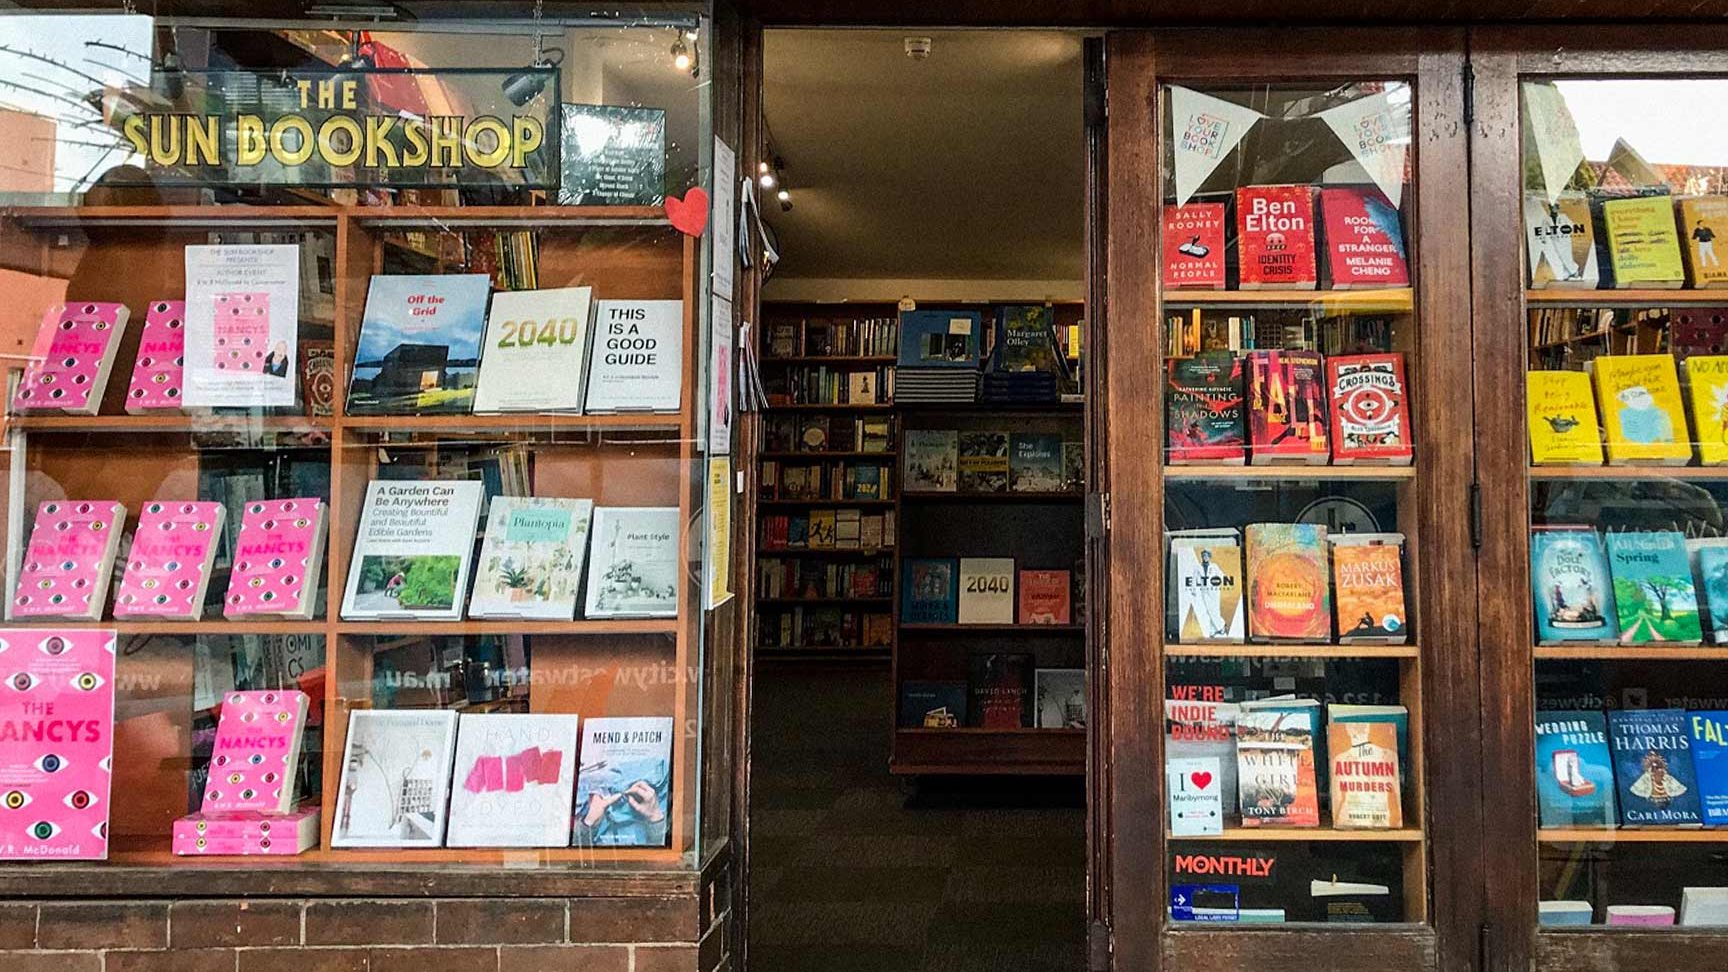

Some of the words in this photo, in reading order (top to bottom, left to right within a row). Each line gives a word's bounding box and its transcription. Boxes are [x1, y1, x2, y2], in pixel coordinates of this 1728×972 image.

[297, 80, 357, 109] THE
[122, 113, 222, 167] SUN
[235, 114, 544, 168] BOOKSHOP
[1253, 198, 1296, 215] Ben
[1176, 211, 1212, 220] SALLY
[1168, 220, 1220, 231] ROONEY
[1246, 214, 1305, 232] Elton
[1354, 226, 1377, 235] FOR
[1534, 224, 1585, 237] ELTON
[1362, 235, 1371, 244] A
[1338, 244, 1397, 253] STRANGER
[1257, 253, 1296, 265] IDENTITY
[1345, 257, 1394, 267] MELANIE
[1170, 262, 1218, 270] NORMAL
[1263, 265, 1293, 276] CRISIS
[1351, 266, 1391, 276] CHENG
[1173, 269, 1215, 279] PEOPLE
[407, 295, 426, 305] Off
[427, 295, 445, 305] the
[412, 307, 437, 317] Grid
[609, 308, 646, 320] THIS
[498, 317, 578, 349] 2040
[608, 324, 623, 335] IS
[627, 324, 640, 335] A
[1007, 328, 1048, 340] Margaret
[606, 338, 657, 350] GOOD
[1006, 338, 1030, 347] Olley
[604, 353, 657, 366] GUIDE
[1339, 374, 1396, 392] CROSSINGS
[1174, 392, 1238, 402] PAINTING
[1174, 409, 1239, 420] SHADOWS
[1018, 441, 1034, 450] She
[377, 486, 386, 496] A
[388, 486, 430, 496] Garden
[432, 486, 455, 496] Can
[375, 497, 390, 506] Be
[391, 497, 449, 509] Anywhere
[372, 508, 409, 518] Creating
[410, 507, 449, 516] Bountiful
[370, 518, 388, 526] and
[388, 518, 427, 526] Beautiful
[513, 516, 566, 532] Plantopia
[368, 528, 395, 537] Edible
[396, 528, 433, 537] Gardens
[626, 532, 648, 541] Plant
[650, 532, 670, 542] Style
[241, 541, 305, 557] NANCYS
[1616, 551, 1660, 565] Spring
[1340, 561, 1395, 574] MARKUS
[1548, 564, 1592, 579] FACTORY
[966, 575, 1009, 594] 2040
[1185, 576, 1235, 587] ELTON
[1341, 574, 1398, 588] ZUSAK
[1171, 685, 1225, 703] WE'RE
[22, 702, 55, 715] THE
[1170, 705, 1217, 722] INDIE
[1171, 724, 1231, 741] BOUND
[1536, 721, 1588, 735] WEDDING
[1619, 723, 1680, 735] THOMAS
[1692, 716, 1728, 747] FAL
[219, 736, 287, 750] NANCYS
[593, 731, 620, 744] MEND
[622, 731, 629, 744] &
[631, 731, 662, 743] PATCH
[1562, 731, 1607, 745] PUZZLE
[1615, 735, 1689, 751] HARRIS
[1355, 742, 1373, 758] The
[1245, 755, 1313, 767] WHITE
[1335, 761, 1395, 777] AUTUMN
[1179, 772, 1185, 792] I
[1339, 781, 1393, 793] MURDERS
[1248, 806, 1277, 816] TONY
[1279, 806, 1314, 816] BIRCH
[23, 843, 80, 856] McDonald
[1175, 855, 1276, 877] MONTHLY
